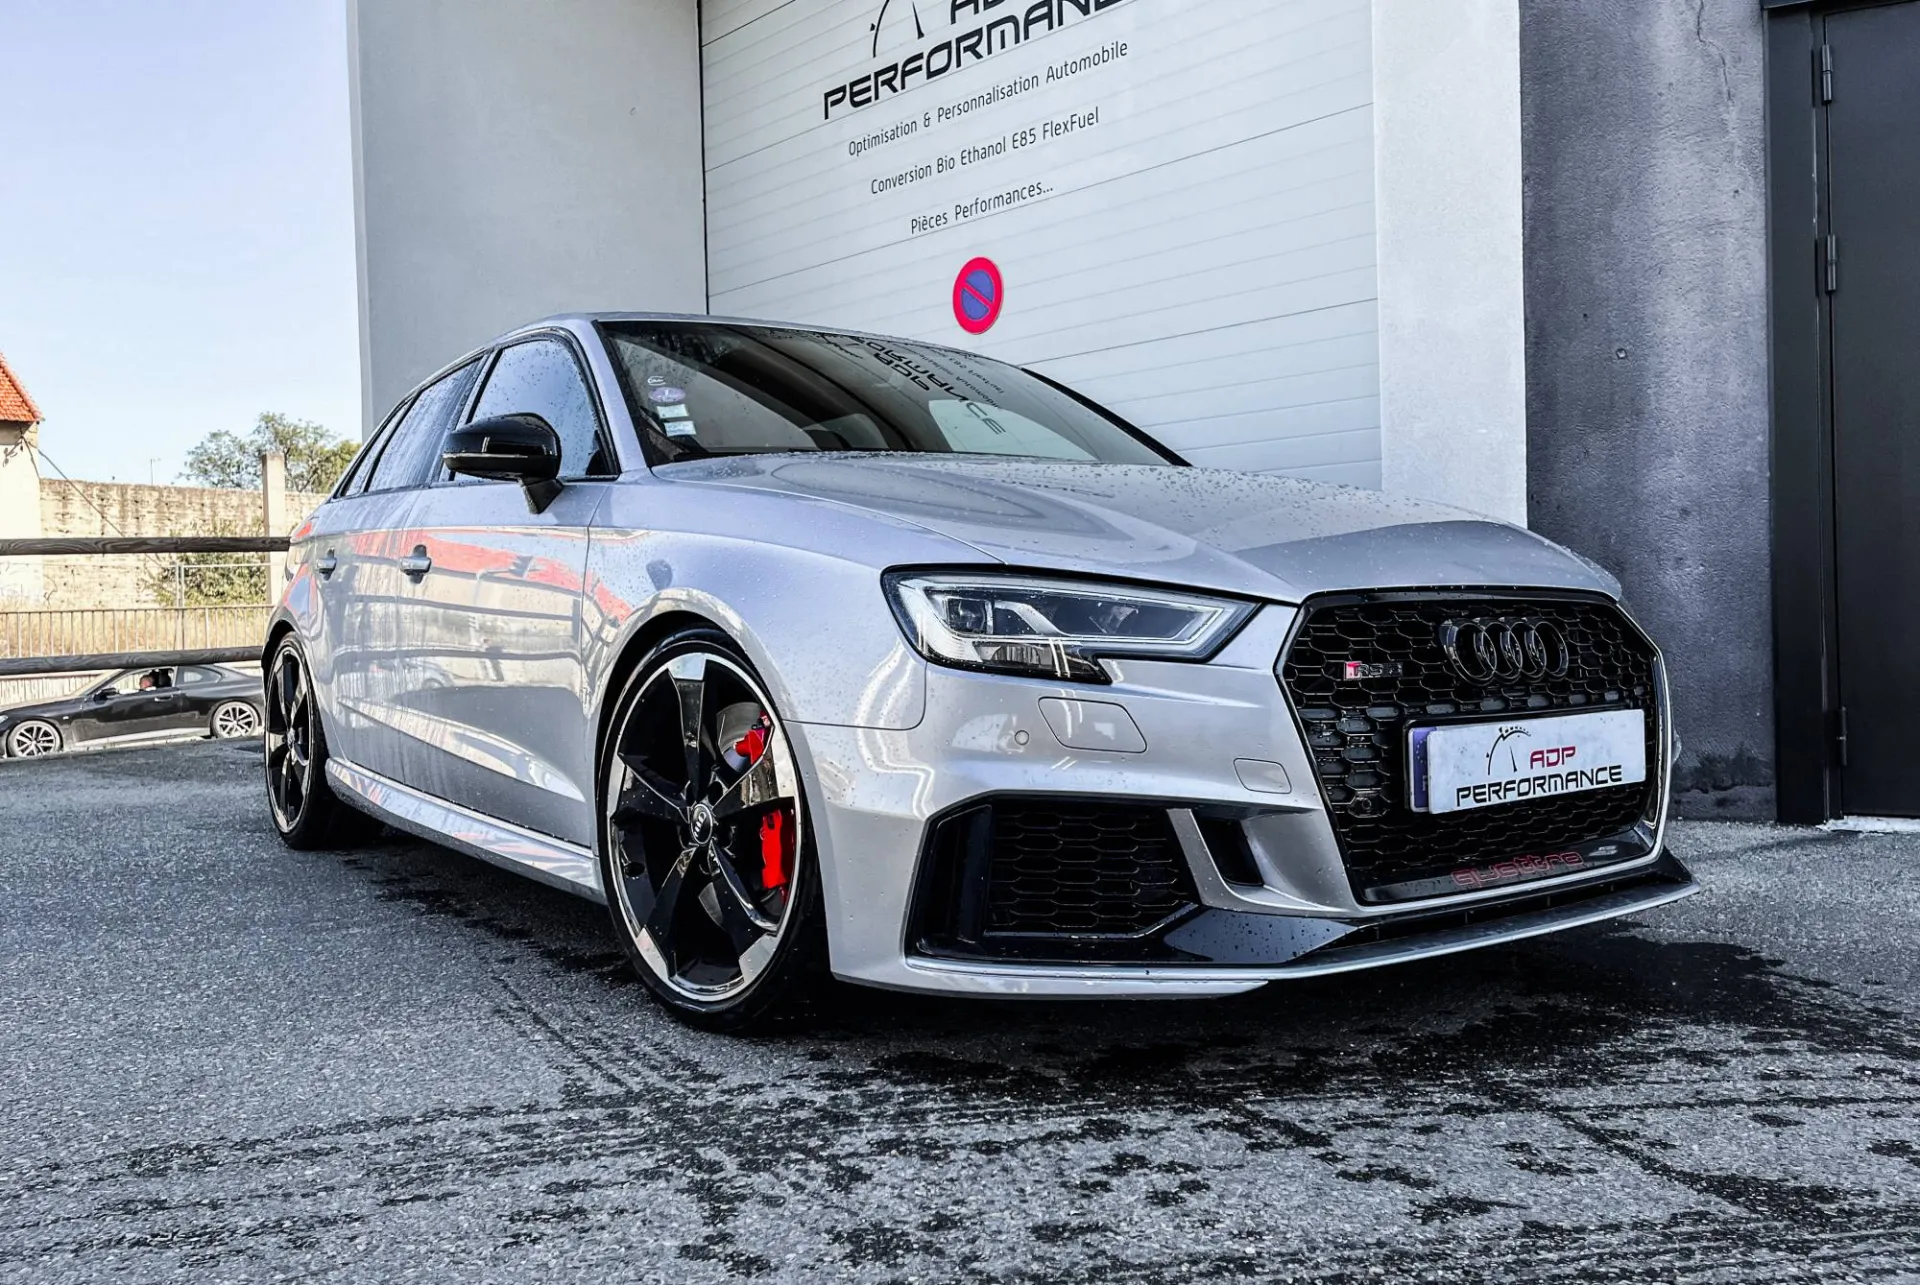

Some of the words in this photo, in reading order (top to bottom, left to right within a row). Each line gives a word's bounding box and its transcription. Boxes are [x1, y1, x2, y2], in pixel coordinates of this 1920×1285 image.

[823, 0, 1122, 120] PERFORMAN
[848, 119, 918, 156] Optimisation
[923, 112, 931, 128] &
[937, 74, 1040, 122] Personnalisation
[1045, 40, 1129, 84] Automobile
[871, 164, 932, 195] Conversion
[937, 155, 956, 174] Bio
[960, 135, 1006, 166] Ethanol
[1012, 127, 1037, 150] E85
[1042, 105, 1100, 140] FlexFuel
[911, 211, 949, 235] Pièces
[955, 181, 1054, 221] Performances...
[1456, 764, 1623, 807] PERFORMANCE
[1529, 745, 1577, 769] ADP
